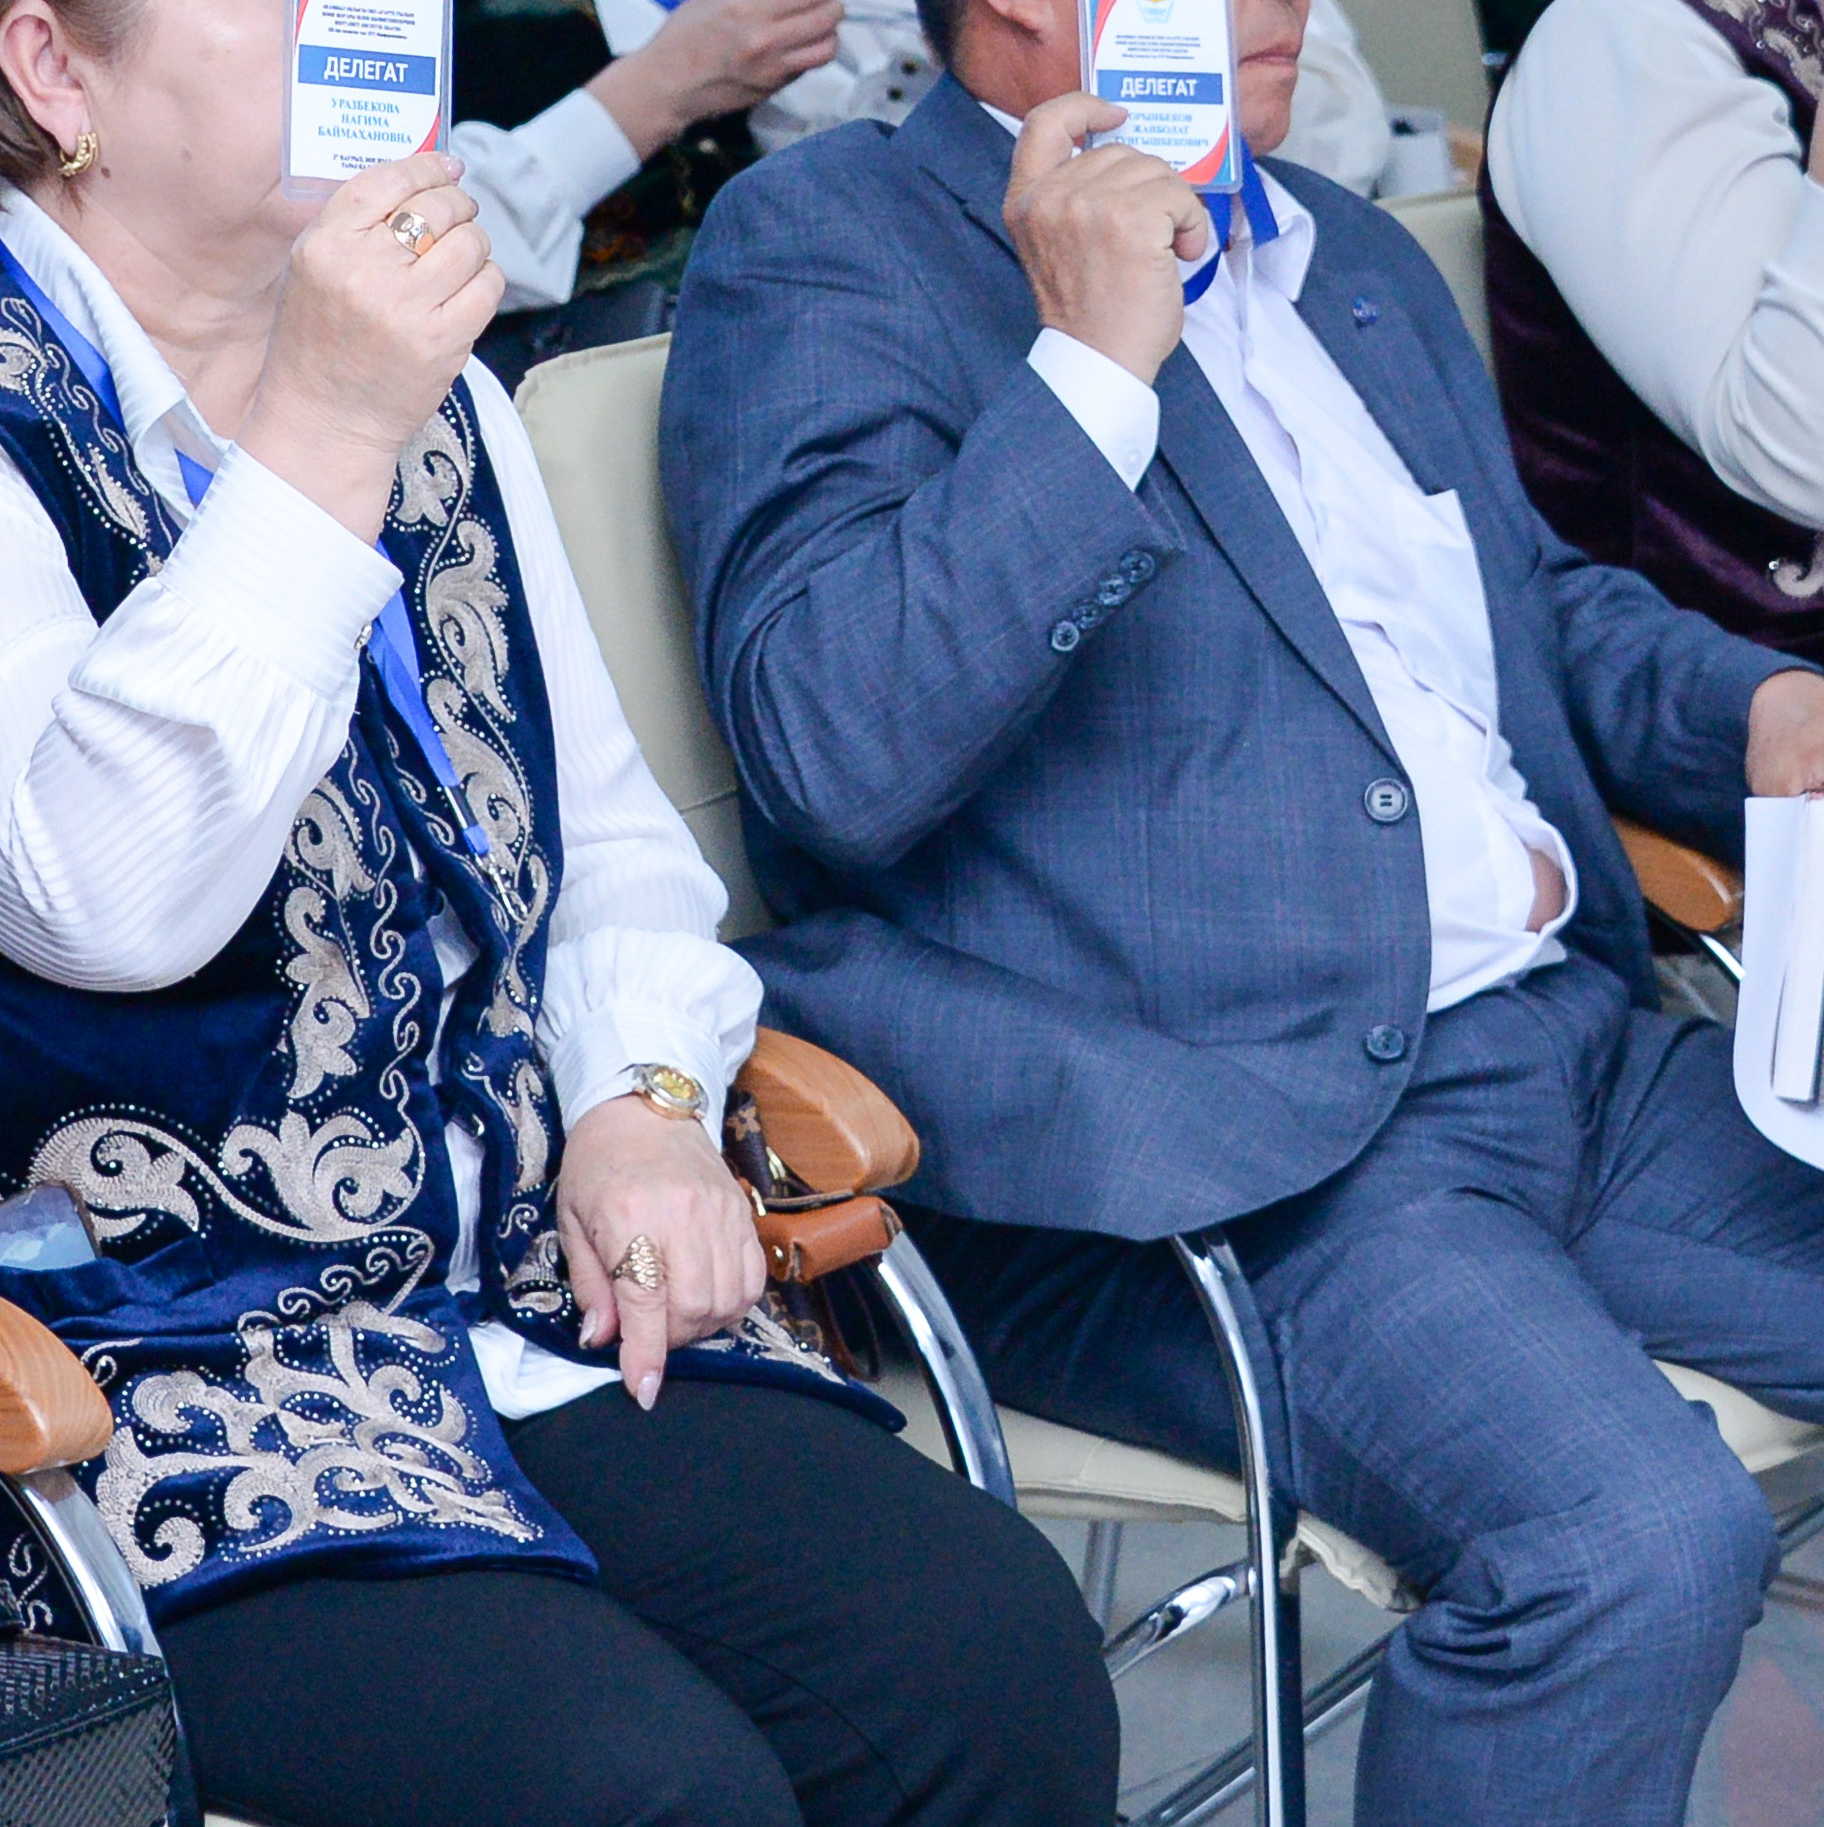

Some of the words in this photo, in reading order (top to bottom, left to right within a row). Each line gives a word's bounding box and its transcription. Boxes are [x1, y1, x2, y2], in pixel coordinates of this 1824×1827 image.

[324, 56, 409, 83] ДЕЛЕГАТ
[1120, 77, 1197, 98] ДЕЛЕГАТ
[331, 97, 400, 114] УРАЗБЕКОВА
[341, 113, 389, 127] НАГИМА
[318, 126, 412, 144] БАЙМАХАНОВНА
